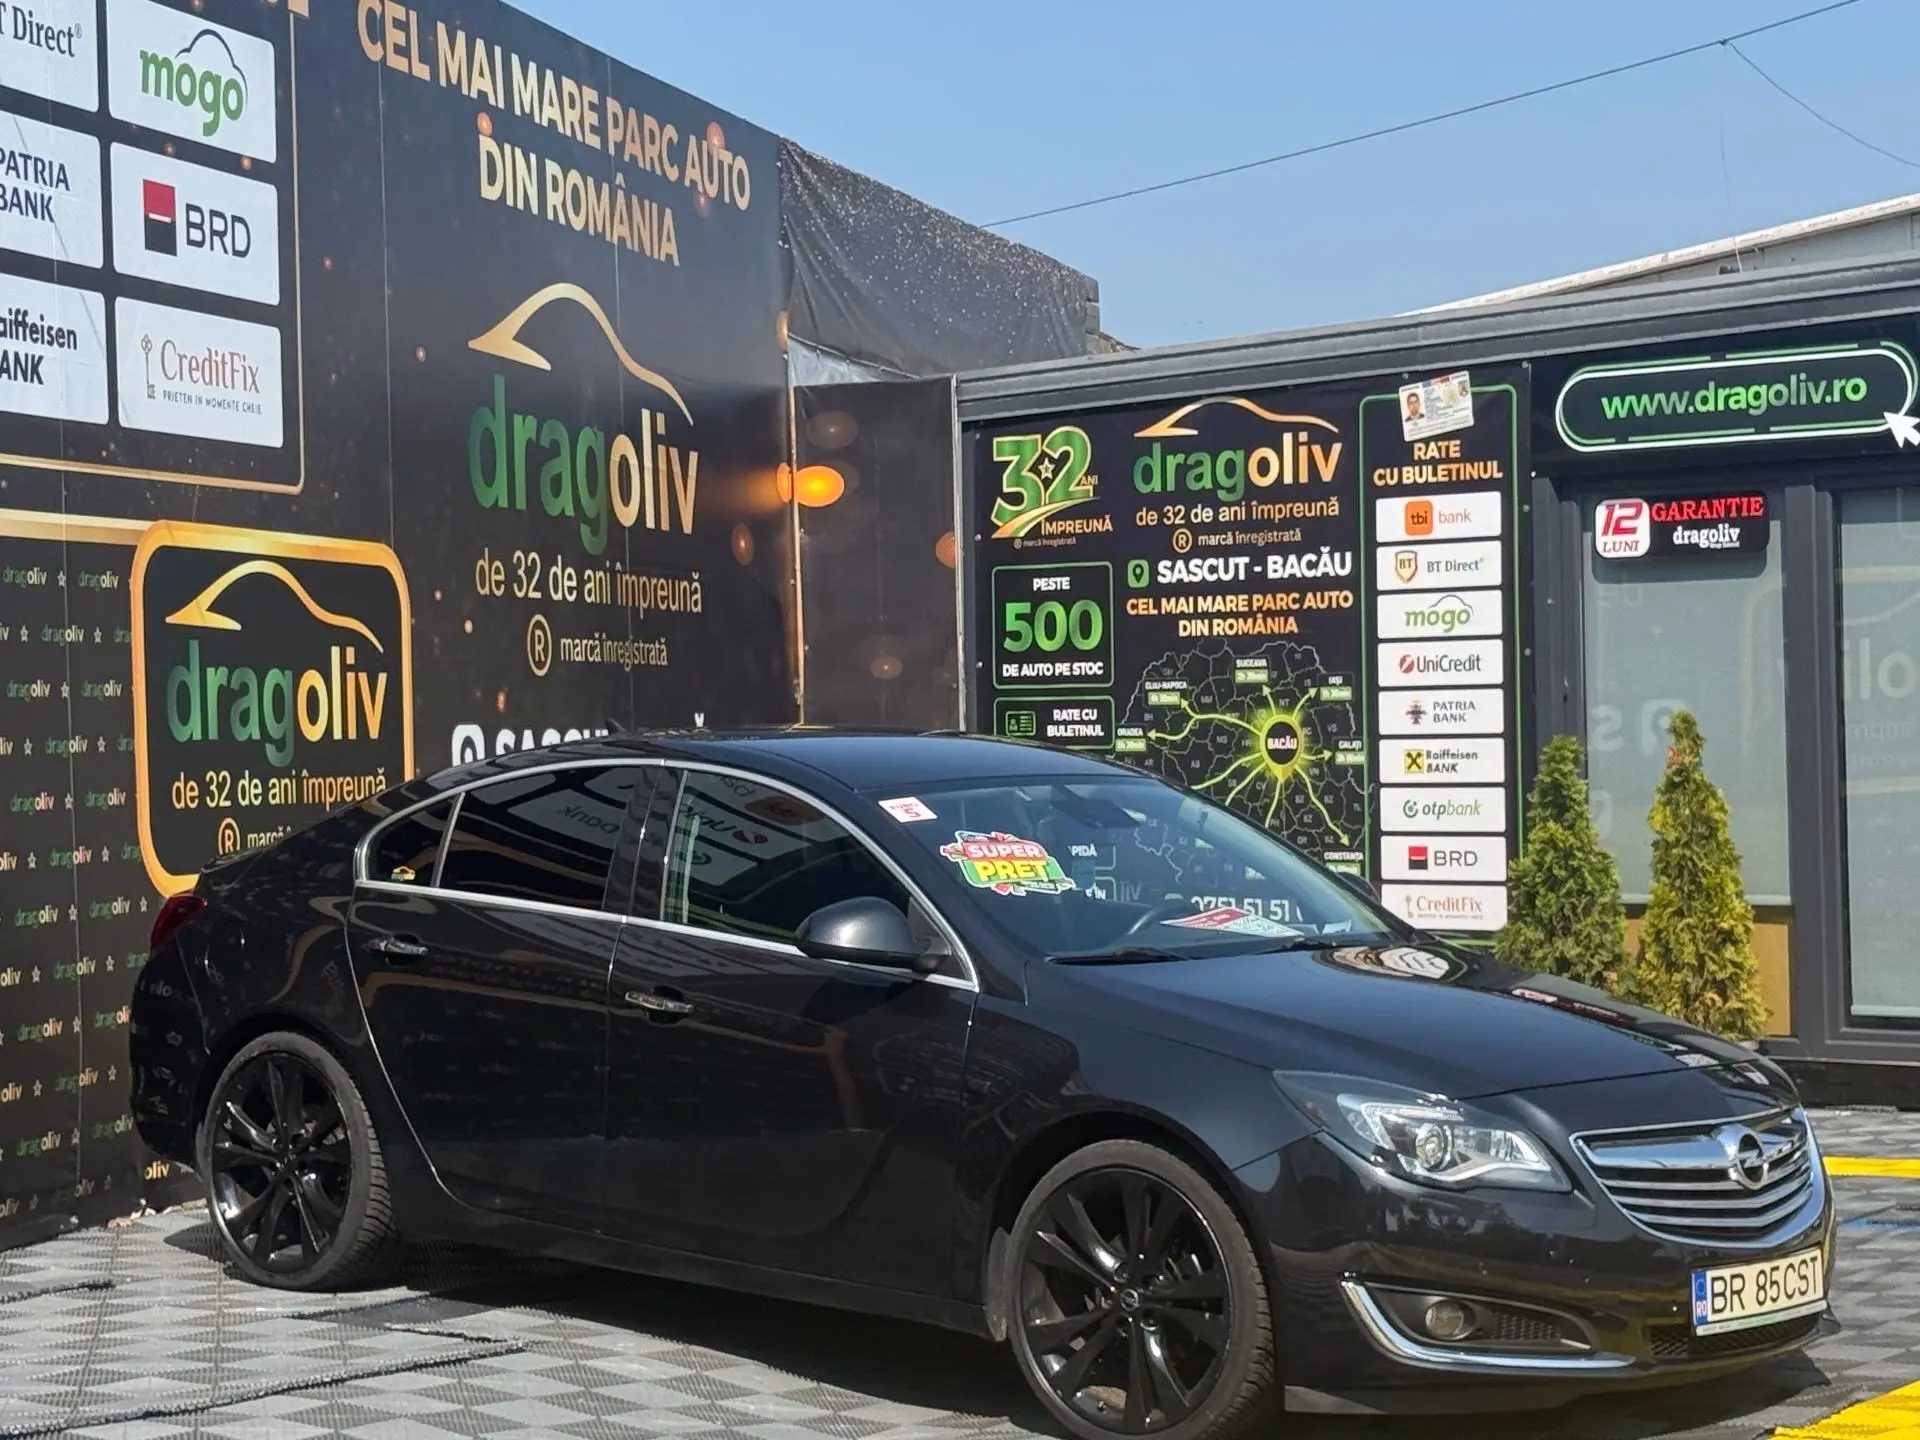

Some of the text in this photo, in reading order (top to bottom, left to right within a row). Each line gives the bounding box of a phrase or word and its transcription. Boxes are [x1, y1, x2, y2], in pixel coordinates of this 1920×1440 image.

[139, 50, 243, 137] mogo
[357, 0, 751, 211] CEL MAI MARE PARC AUTO
[479, 134, 680, 267] DIN ROMÂNIA
[186, 203, 251, 258] BRD
[0, 308, 77, 350] aiffeisen
[0, 349, 44, 385] ANK
[161, 339, 260, 394] CreditFix
[1601, 372, 1868, 420] www.dragoliv.ro
[1413, 440, 1461, 461] RATE
[469, 374, 698, 555] dragoliv
[990, 425, 1091, 527] 32
[1133, 431, 1343, 502] dragoliv
[1373, 460, 1503, 486] CU BULETINUL
[1136, 496, 1340, 526] de 32 de ani împreună
[1410, 508, 1472, 526] tbi bank
[1601, 502, 1643, 537] 12
[1651, 496, 1764, 522] GARANTIE
[1198, 531, 1233, 547] marcă
[1234, 528, 1302, 547] înregistrată
[1603, 540, 1640, 554] LUNI
[1673, 522, 1740, 549] dragoliv
[1157, 556, 1250, 584] SASCUT
[1267, 546, 1352, 579] BACĂU
[1399, 558, 1413, 569] BT
[1427, 561, 1442, 573] BT
[476, 547, 702, 619] de 32 de ani împreună
[1033, 576, 1070, 592] PESTE
[1126, 590, 1354, 616] CEL MAI MARE PARC AUTO
[1003, 599, 1104, 653] 500
[1178, 613, 1298, 638] DIN ROMÂNIA
[1404, 608, 1471, 634] mogo
[560, 632, 602, 663] marcă
[1002, 661, 1104, 677] DE AUTO PE STOC
[1416, 654, 1482, 673] UniCredit
[167, 639, 388, 767] dragoliv
[1053, 708, 1097, 722] RATE CU
[1433, 701, 1476, 711] PATRIA
[1047, 724, 1104, 738] BULETINUL
[1433, 713, 1467, 724] BANK
[1267, 734, 1298, 750] BACĂU
[1426, 748, 1478, 761] Raiffeisen
[1426, 763, 1459, 774] BANK
[172, 772, 199, 809] de
[205, 770, 231, 808] 32
[238, 770, 262, 806] de
[268, 770, 296, 805] ani
[1422, 798, 1482, 821] otpbank
[968, 843, 1042, 859] SUPER
[1434, 850, 1478, 867] BRD
[1416, 895, 1482, 913] CreditFix
[0, 966, 21, 987] oliv
[1, 1082, 22, 1103] oliv
[144, 1161, 170, 1180] oliv
[1711, 1273, 1745, 1314] BR
